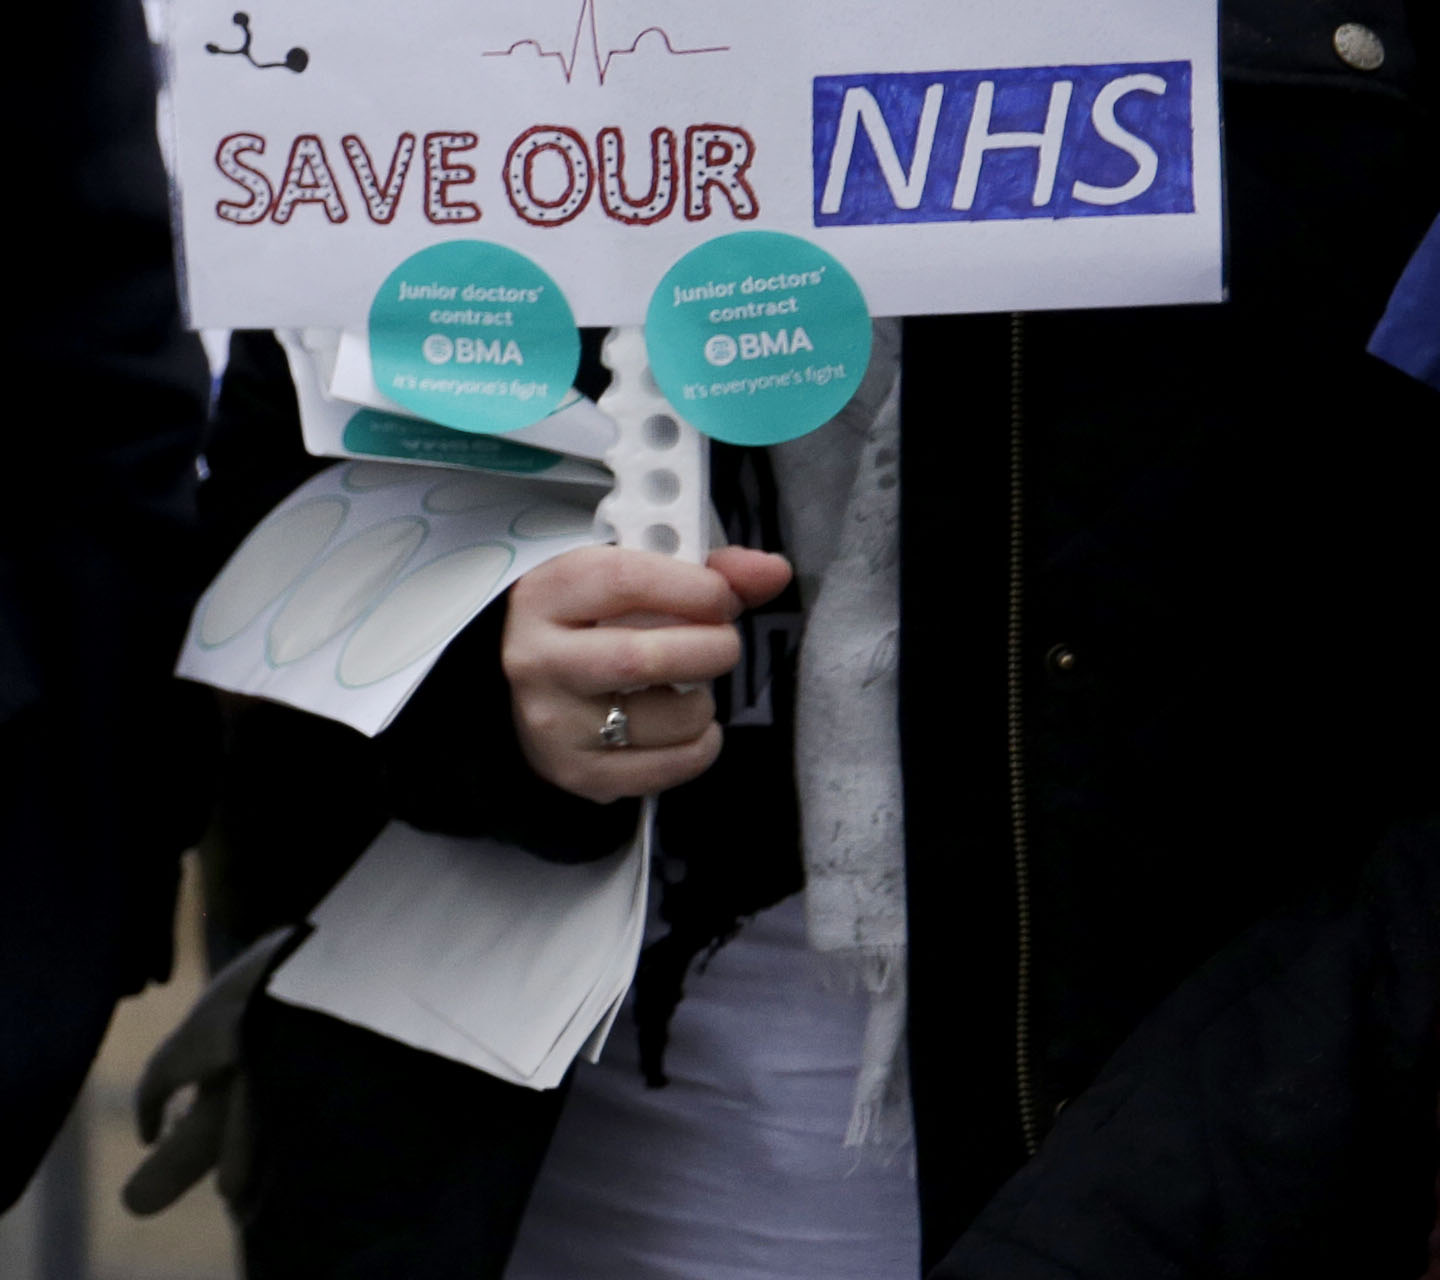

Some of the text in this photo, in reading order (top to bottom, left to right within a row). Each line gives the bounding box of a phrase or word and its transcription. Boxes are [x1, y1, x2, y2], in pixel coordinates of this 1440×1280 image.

[213, 70, 1169, 230] SAVE OUR NHS
[398, 281, 457, 302] Junior
[673, 280, 737, 306] Junior
[429, 307, 514, 327] contract
[709, 294, 799, 325] contract
[454, 335, 524, 366] BMA
[739, 326, 814, 362] BMA
[804, 361, 846, 388] fight
[508, 379, 549, 402] fight
